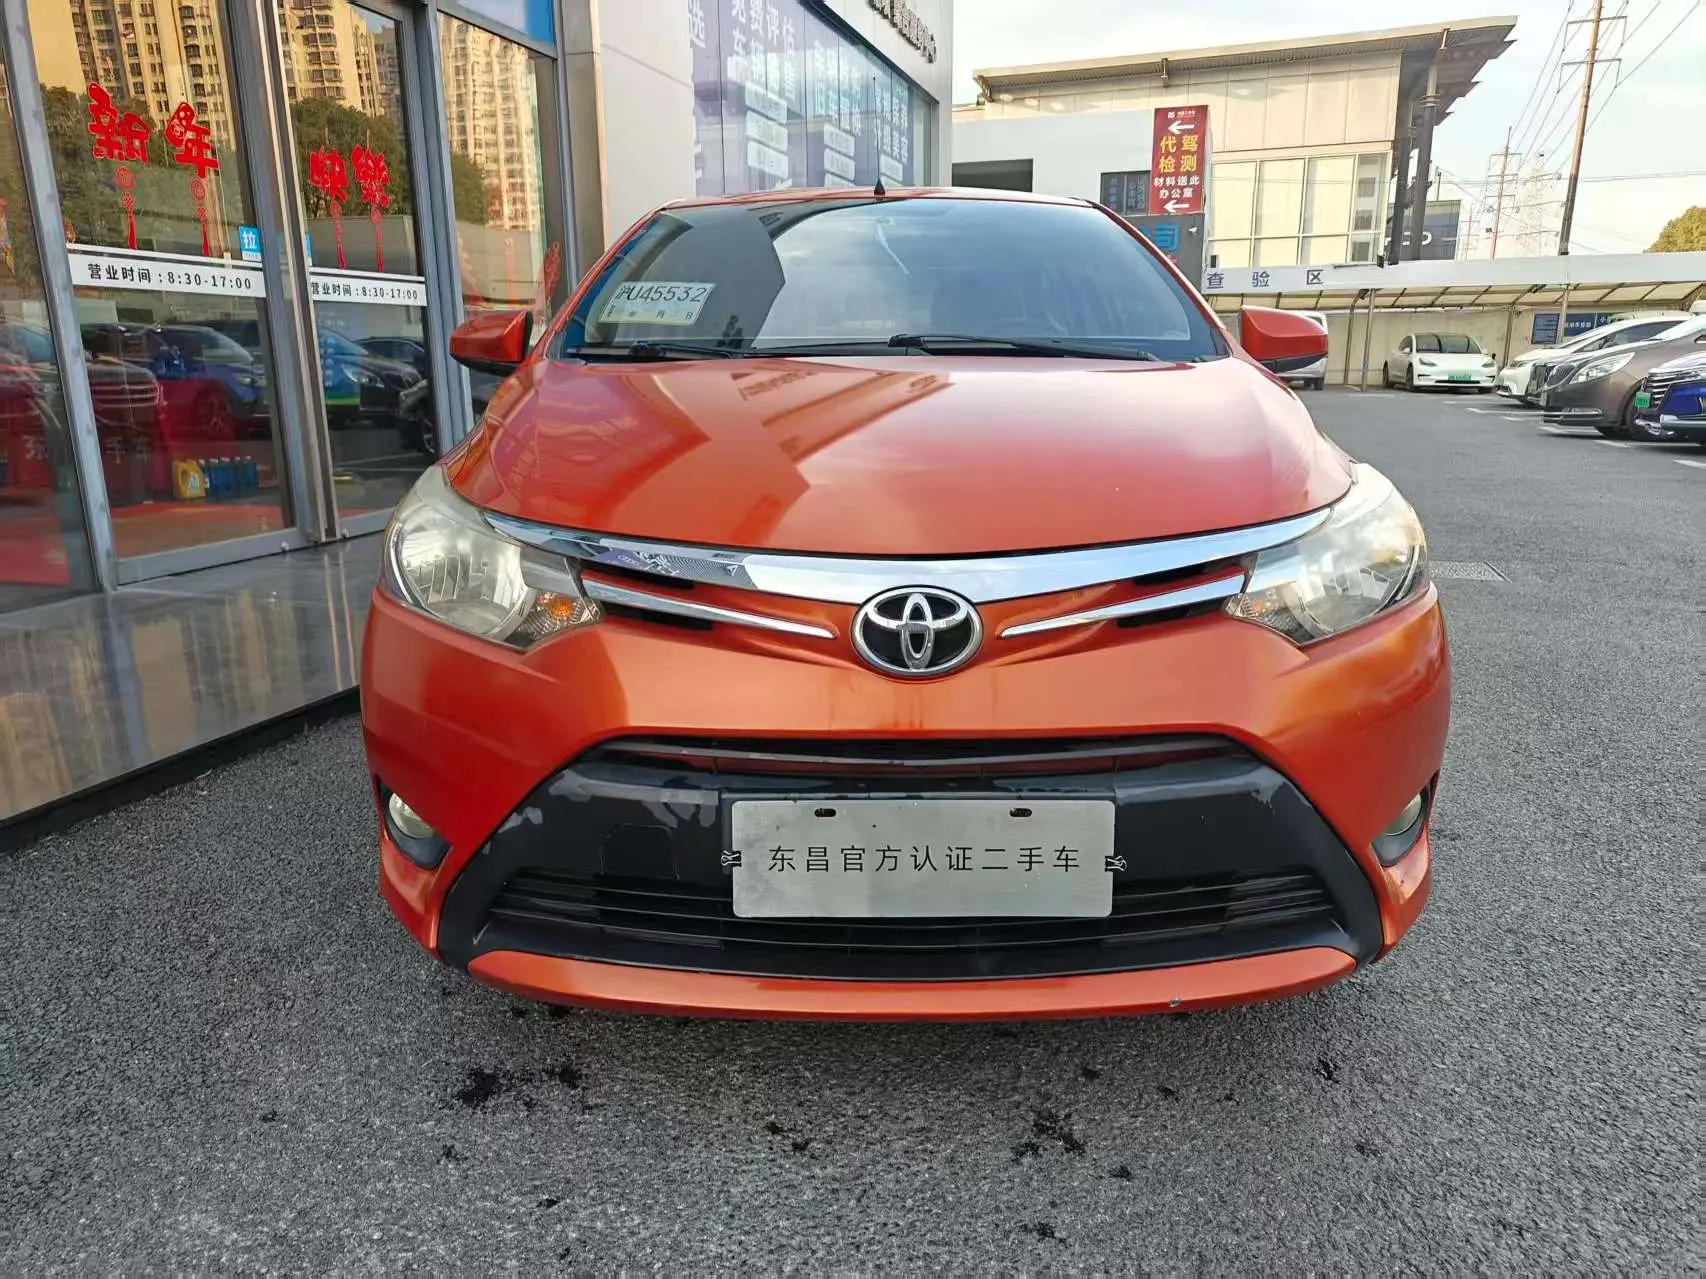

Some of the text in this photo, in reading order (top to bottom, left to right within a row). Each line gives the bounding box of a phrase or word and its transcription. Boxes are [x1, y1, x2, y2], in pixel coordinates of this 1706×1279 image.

[1160, 134, 1199, 154] 代驾
[1159, 155, 1197, 173] 检测
[1154, 175, 1200, 187] 材料送此
[1160, 187, 1193, 199] 办公室
[242, 230, 257, 249] 拉
[1207, 269, 1324, 290] 查验区
[767, 844, 1080, 873] 东昌官方认证二手车
